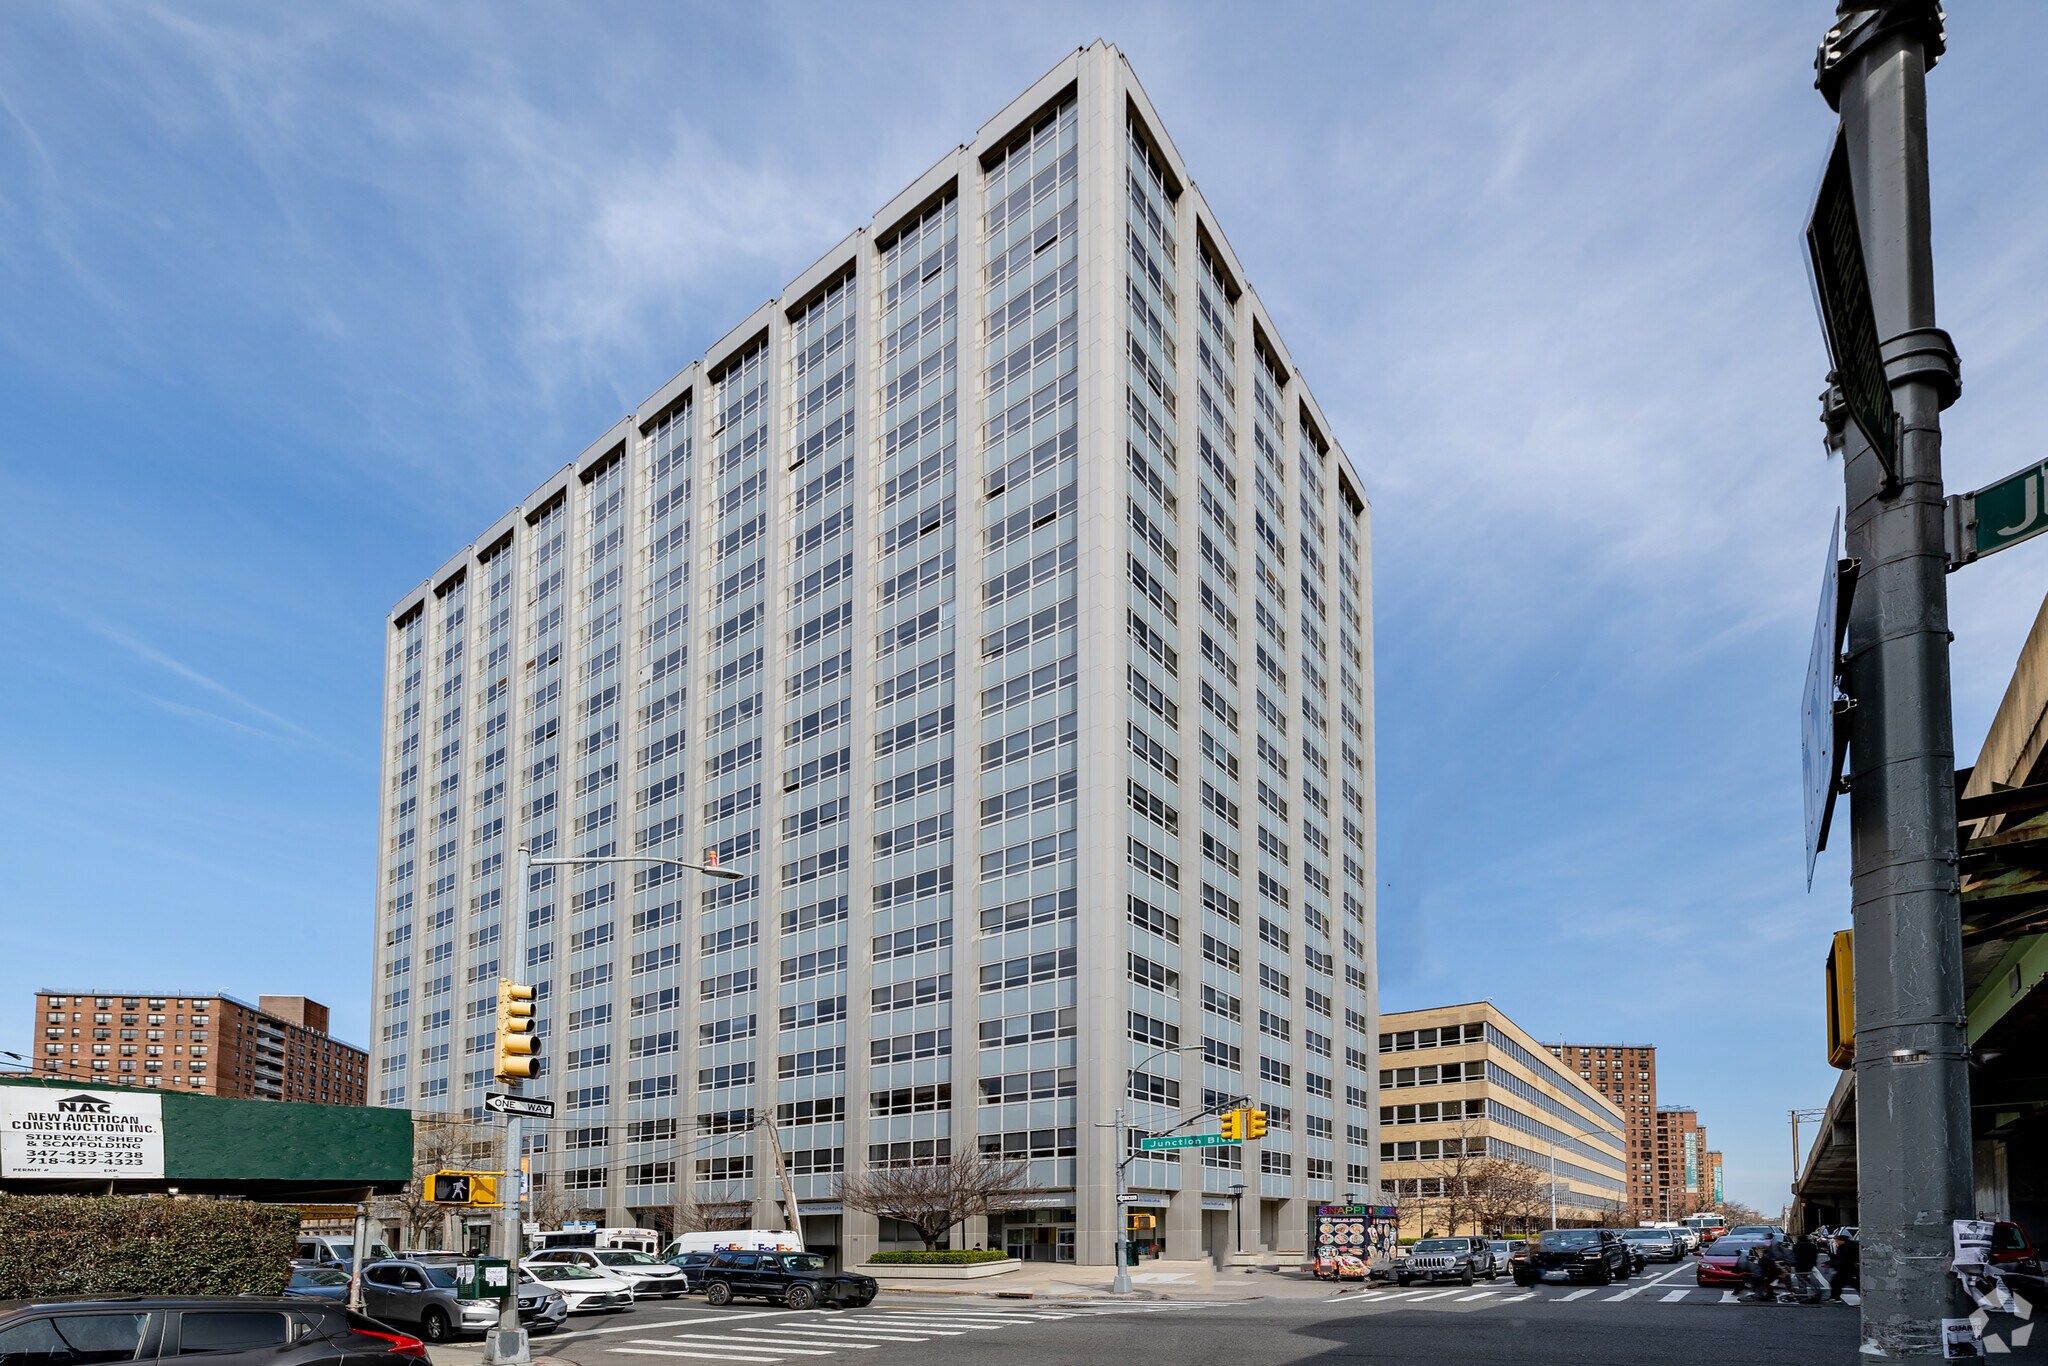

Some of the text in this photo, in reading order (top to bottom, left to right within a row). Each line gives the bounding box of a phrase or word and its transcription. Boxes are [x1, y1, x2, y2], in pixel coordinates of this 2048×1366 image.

[1853, 310, 1888, 433] HARDING
[1997, 466, 2048, 536] J
[58, 1102, 111, 1114] NAC
[494, 1098, 549, 1113] ONE WAY
[27, 1112, 139, 1124] NEW AMERICAN
[12, 1120, 157, 1134] CONSTRUCTION INC.
[25, 1133, 144, 1143] SIDEWALK SHED
[1150, 1138, 1202, 1147] Junction
[42, 1141, 141, 1149] SCAFFOLDING
[26, 1150, 143, 1158] 347-453-3738
[26, 1157, 144, 1166] 718-427-4323
[713, 1243, 793, 1251] FedEx FedEx
